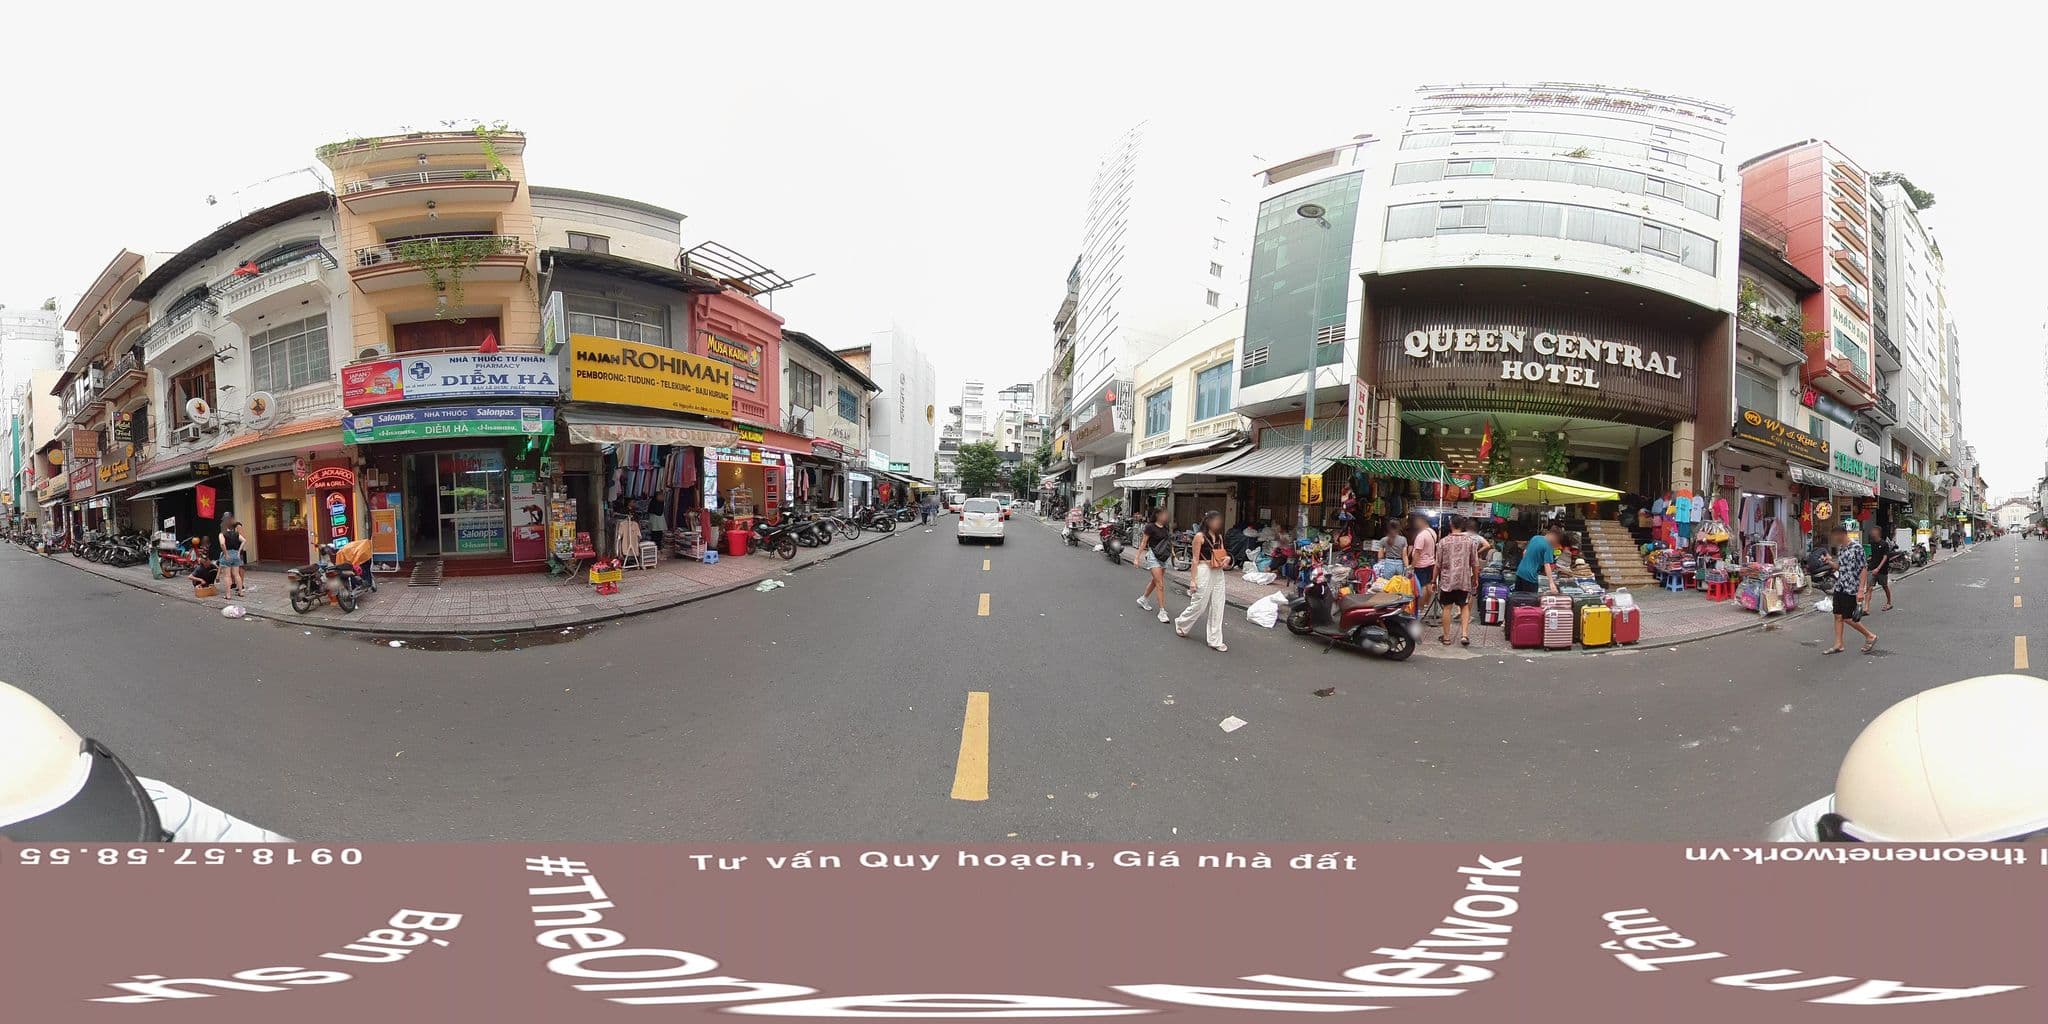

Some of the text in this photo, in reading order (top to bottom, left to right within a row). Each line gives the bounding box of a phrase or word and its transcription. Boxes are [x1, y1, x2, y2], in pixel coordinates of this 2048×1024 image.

[707, 334, 728, 357] MUSA
[1403, 328, 1682, 379] QUEEN CENTRAL
[441, 369, 555, 386] DIỄM HÀ
[576, 350, 620, 366] HAJAH
[622, 348, 729, 386] ROHIMAH
[1500, 360, 1600, 389] HOTEL
[576, 370, 627, 383] PEMBORONG:
[627, 375, 656, 386] TUDUNG
[661, 380, 691, 392] TELEKUNG
[378, 412, 415, 423] Salonpas
[476, 408, 515, 417] Salonpas
[1355, 391, 1366, 457] HOTEL
[308, 468, 353, 482] THE JACKAROO
[462, 529, 498, 538] Salonpas
